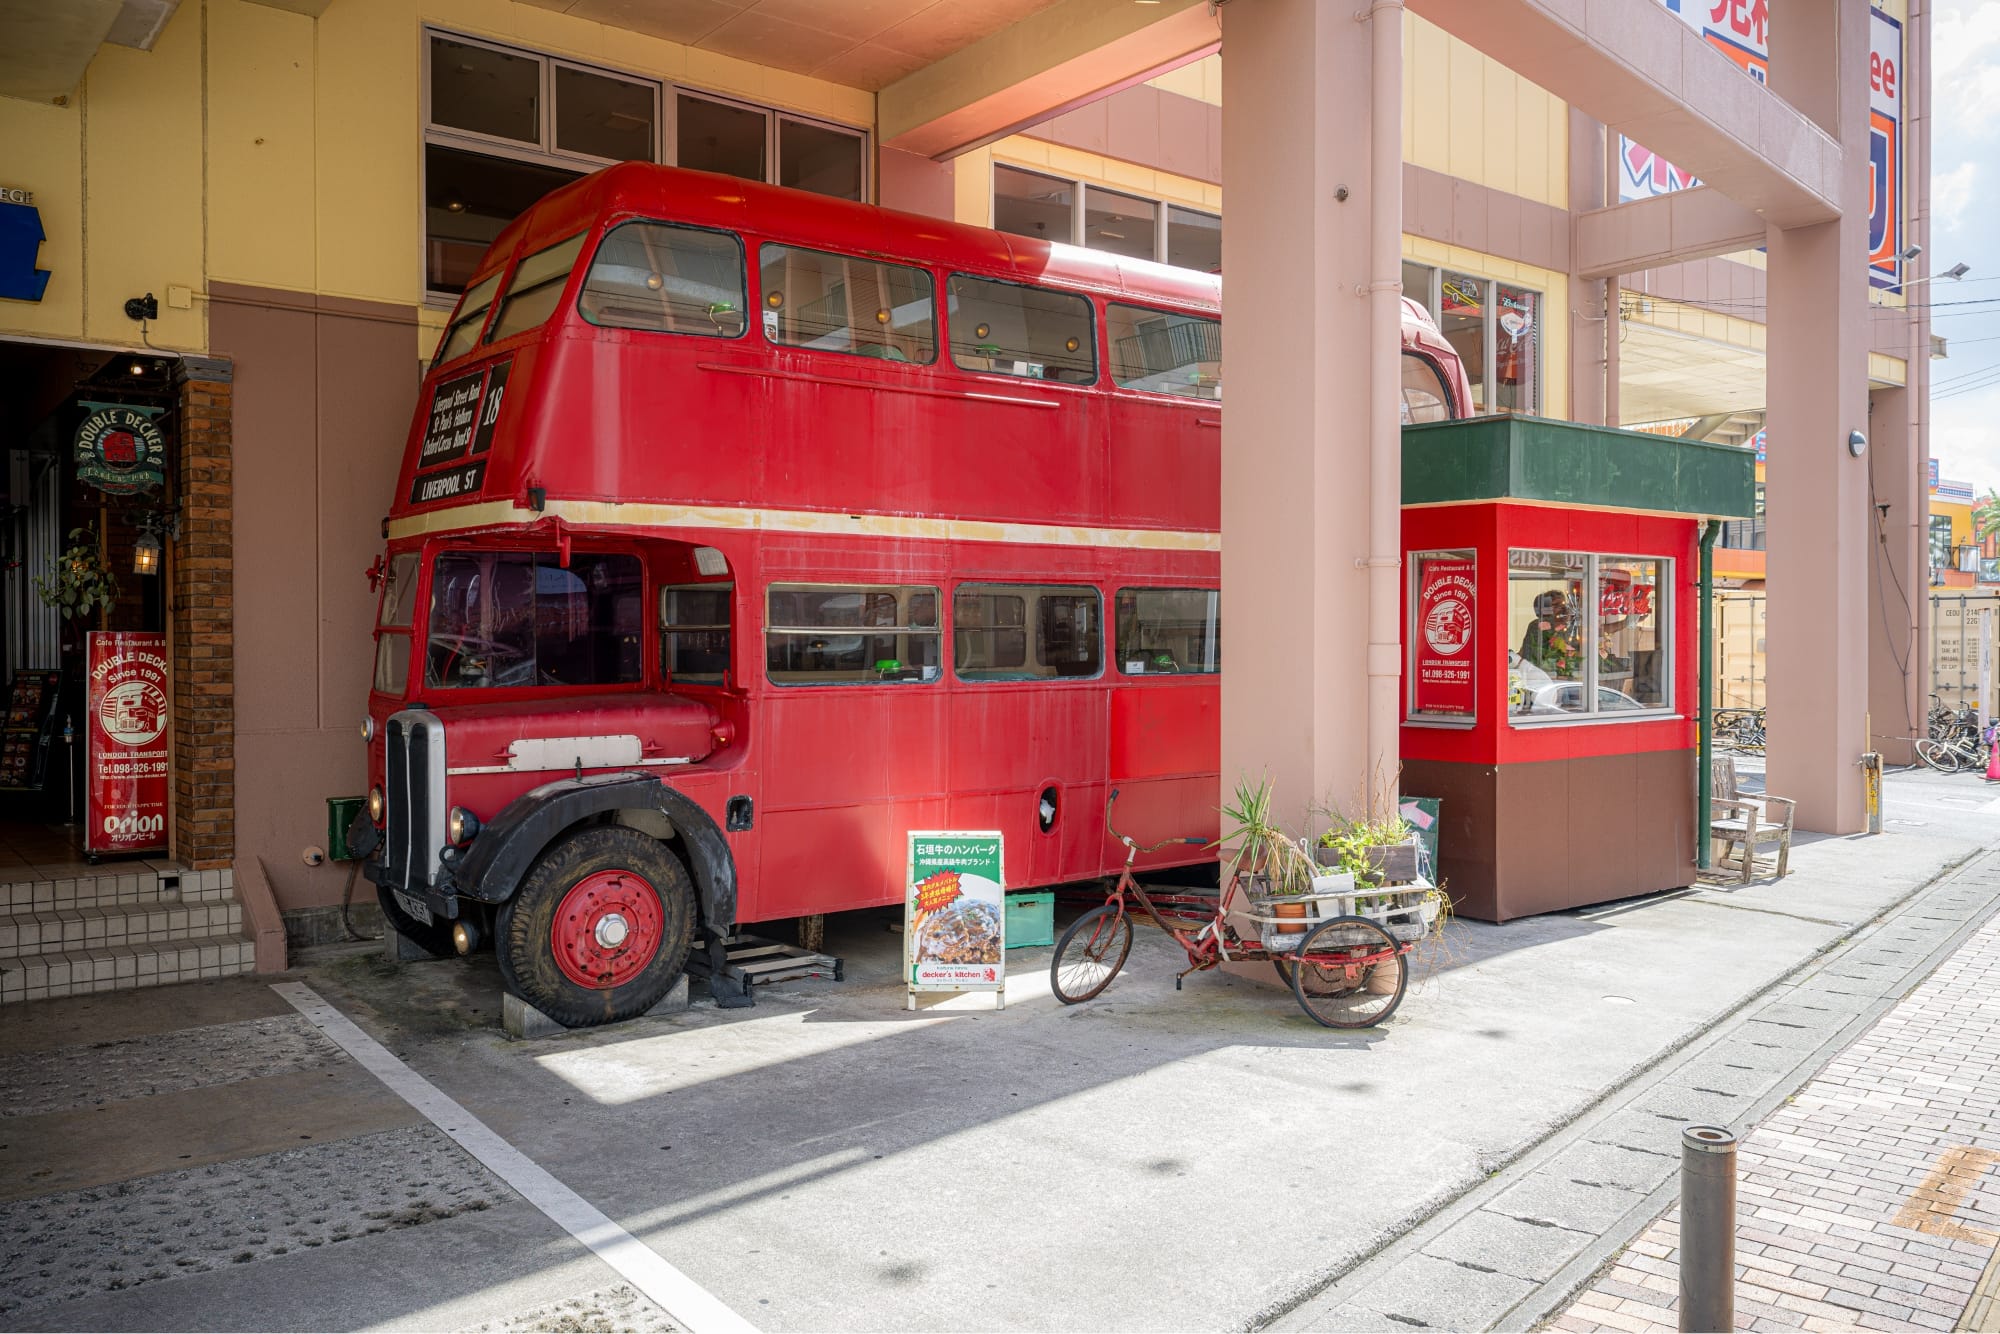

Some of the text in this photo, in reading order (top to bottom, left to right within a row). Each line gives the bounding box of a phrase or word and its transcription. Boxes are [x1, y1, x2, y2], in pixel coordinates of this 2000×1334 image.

[483, 386, 503, 426] 18
[79, 411, 163, 453] DOUBLE DECKER
[421, 469, 477, 500] LIVERPOOL ST
[1423, 575, 1452, 599] DOUBLE
[1433, 589, 1468, 602] Since 1991
[92, 652, 135, 680] DOUBLE
[108, 669, 161, 684] Since 1991
[111, 832, 156, 841] オリオンビール
[916, 844, 997, 855] 石垣牛のハンバーグ
[922, 970, 952, 978] decker's
